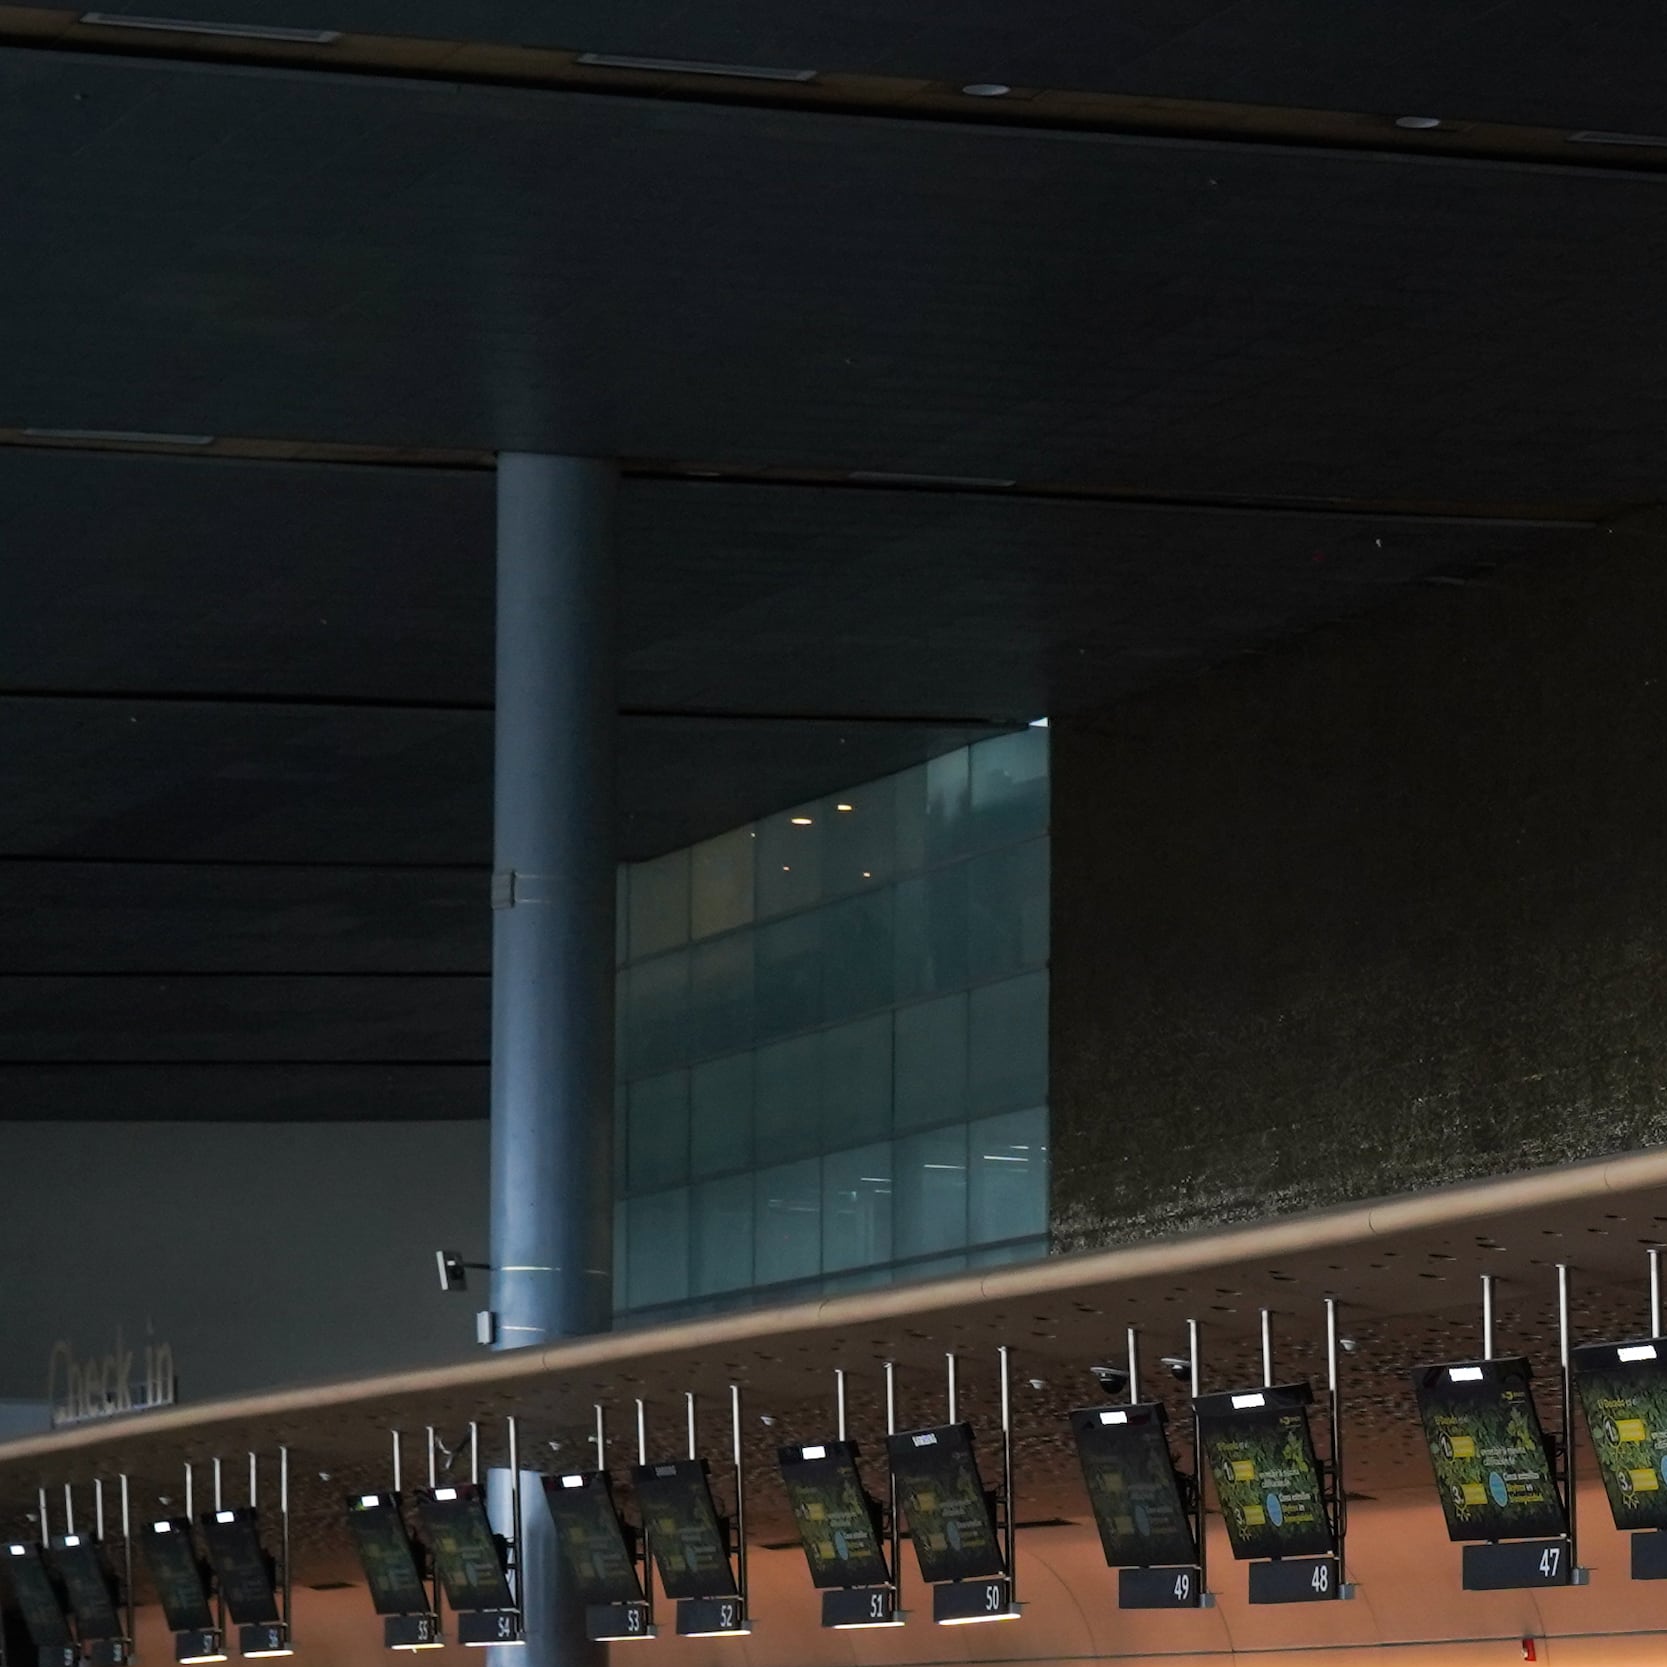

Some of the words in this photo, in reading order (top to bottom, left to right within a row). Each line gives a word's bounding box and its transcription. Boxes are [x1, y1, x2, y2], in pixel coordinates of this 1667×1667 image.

[1539, 1548, 1560, 1577] 47
[1174, 1575, 1190, 1600] 49
[1311, 1566, 1329, 1592] 48
[870, 1595, 884, 1617] 51
[986, 1585, 999, 1610] 50
